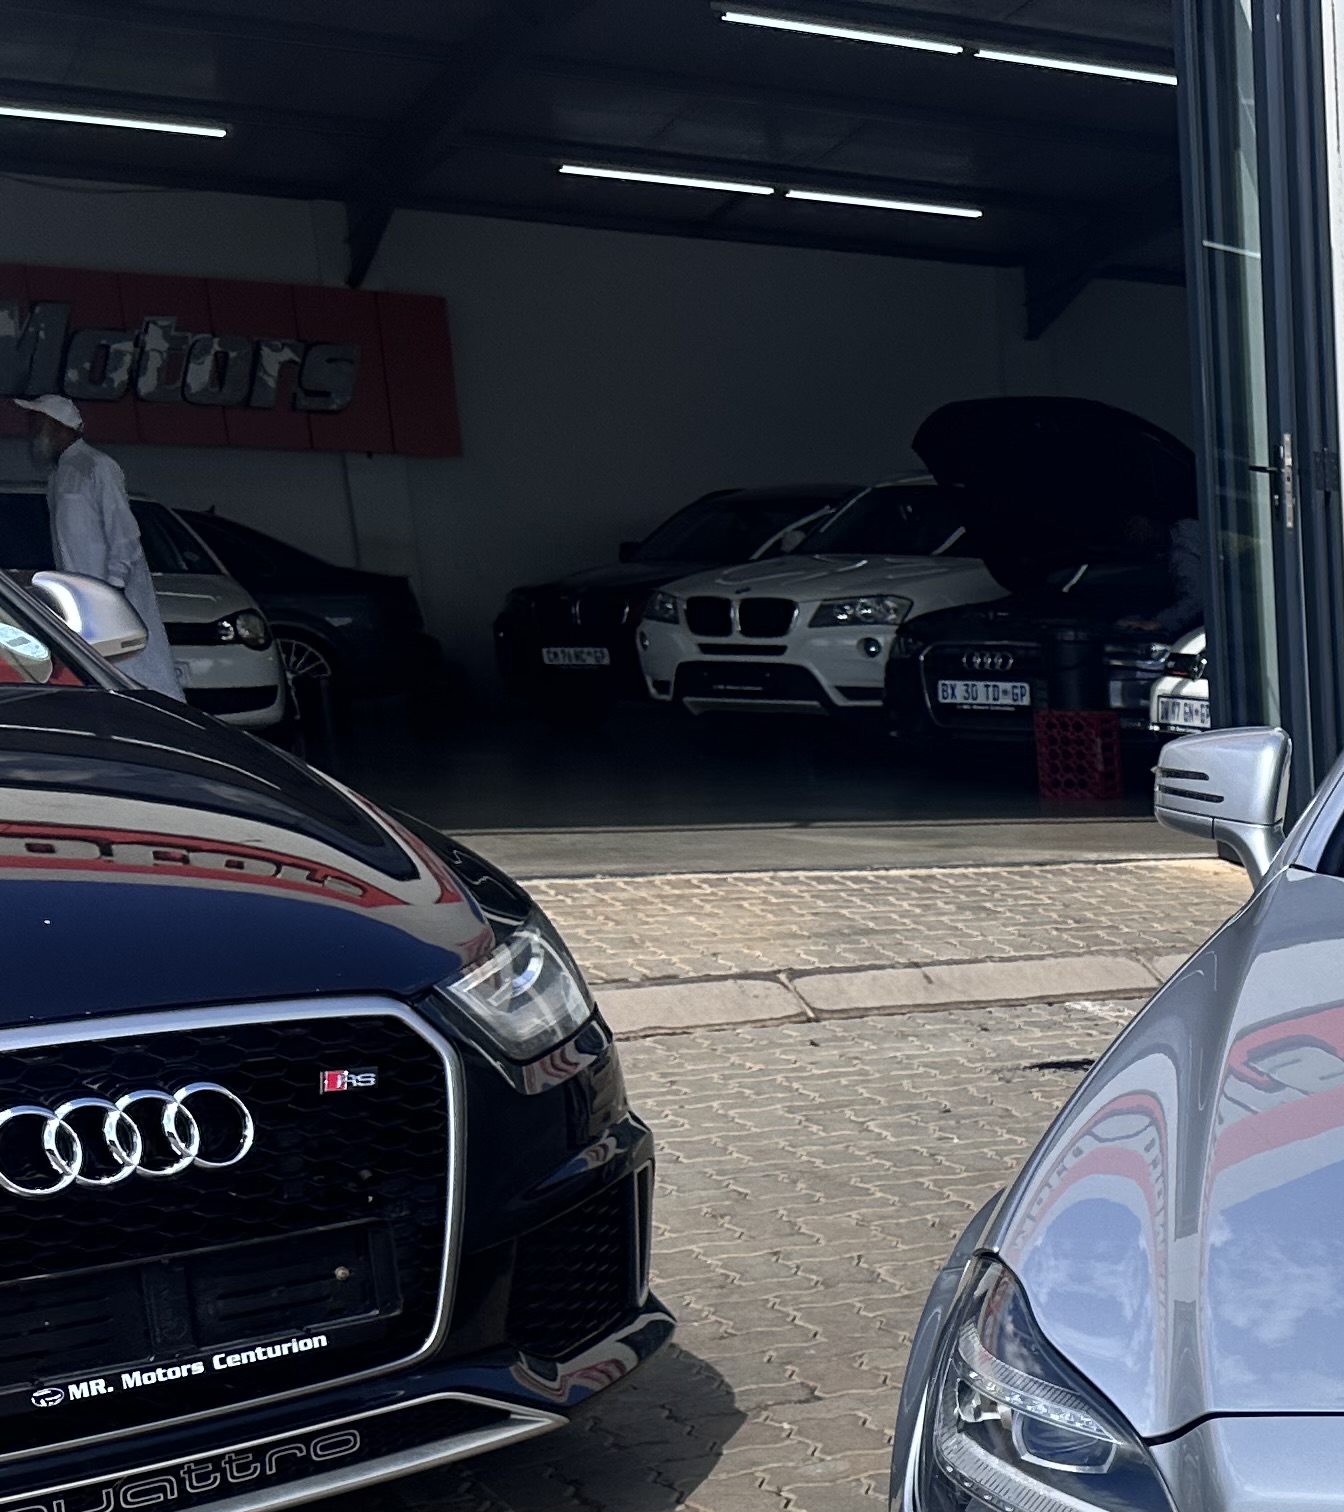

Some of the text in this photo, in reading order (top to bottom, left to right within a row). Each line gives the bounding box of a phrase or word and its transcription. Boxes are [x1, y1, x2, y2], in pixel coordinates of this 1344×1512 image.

[1012, 685, 1027, 702] GP
[68, 1334, 327, 1400] MR. Motors Centurion
